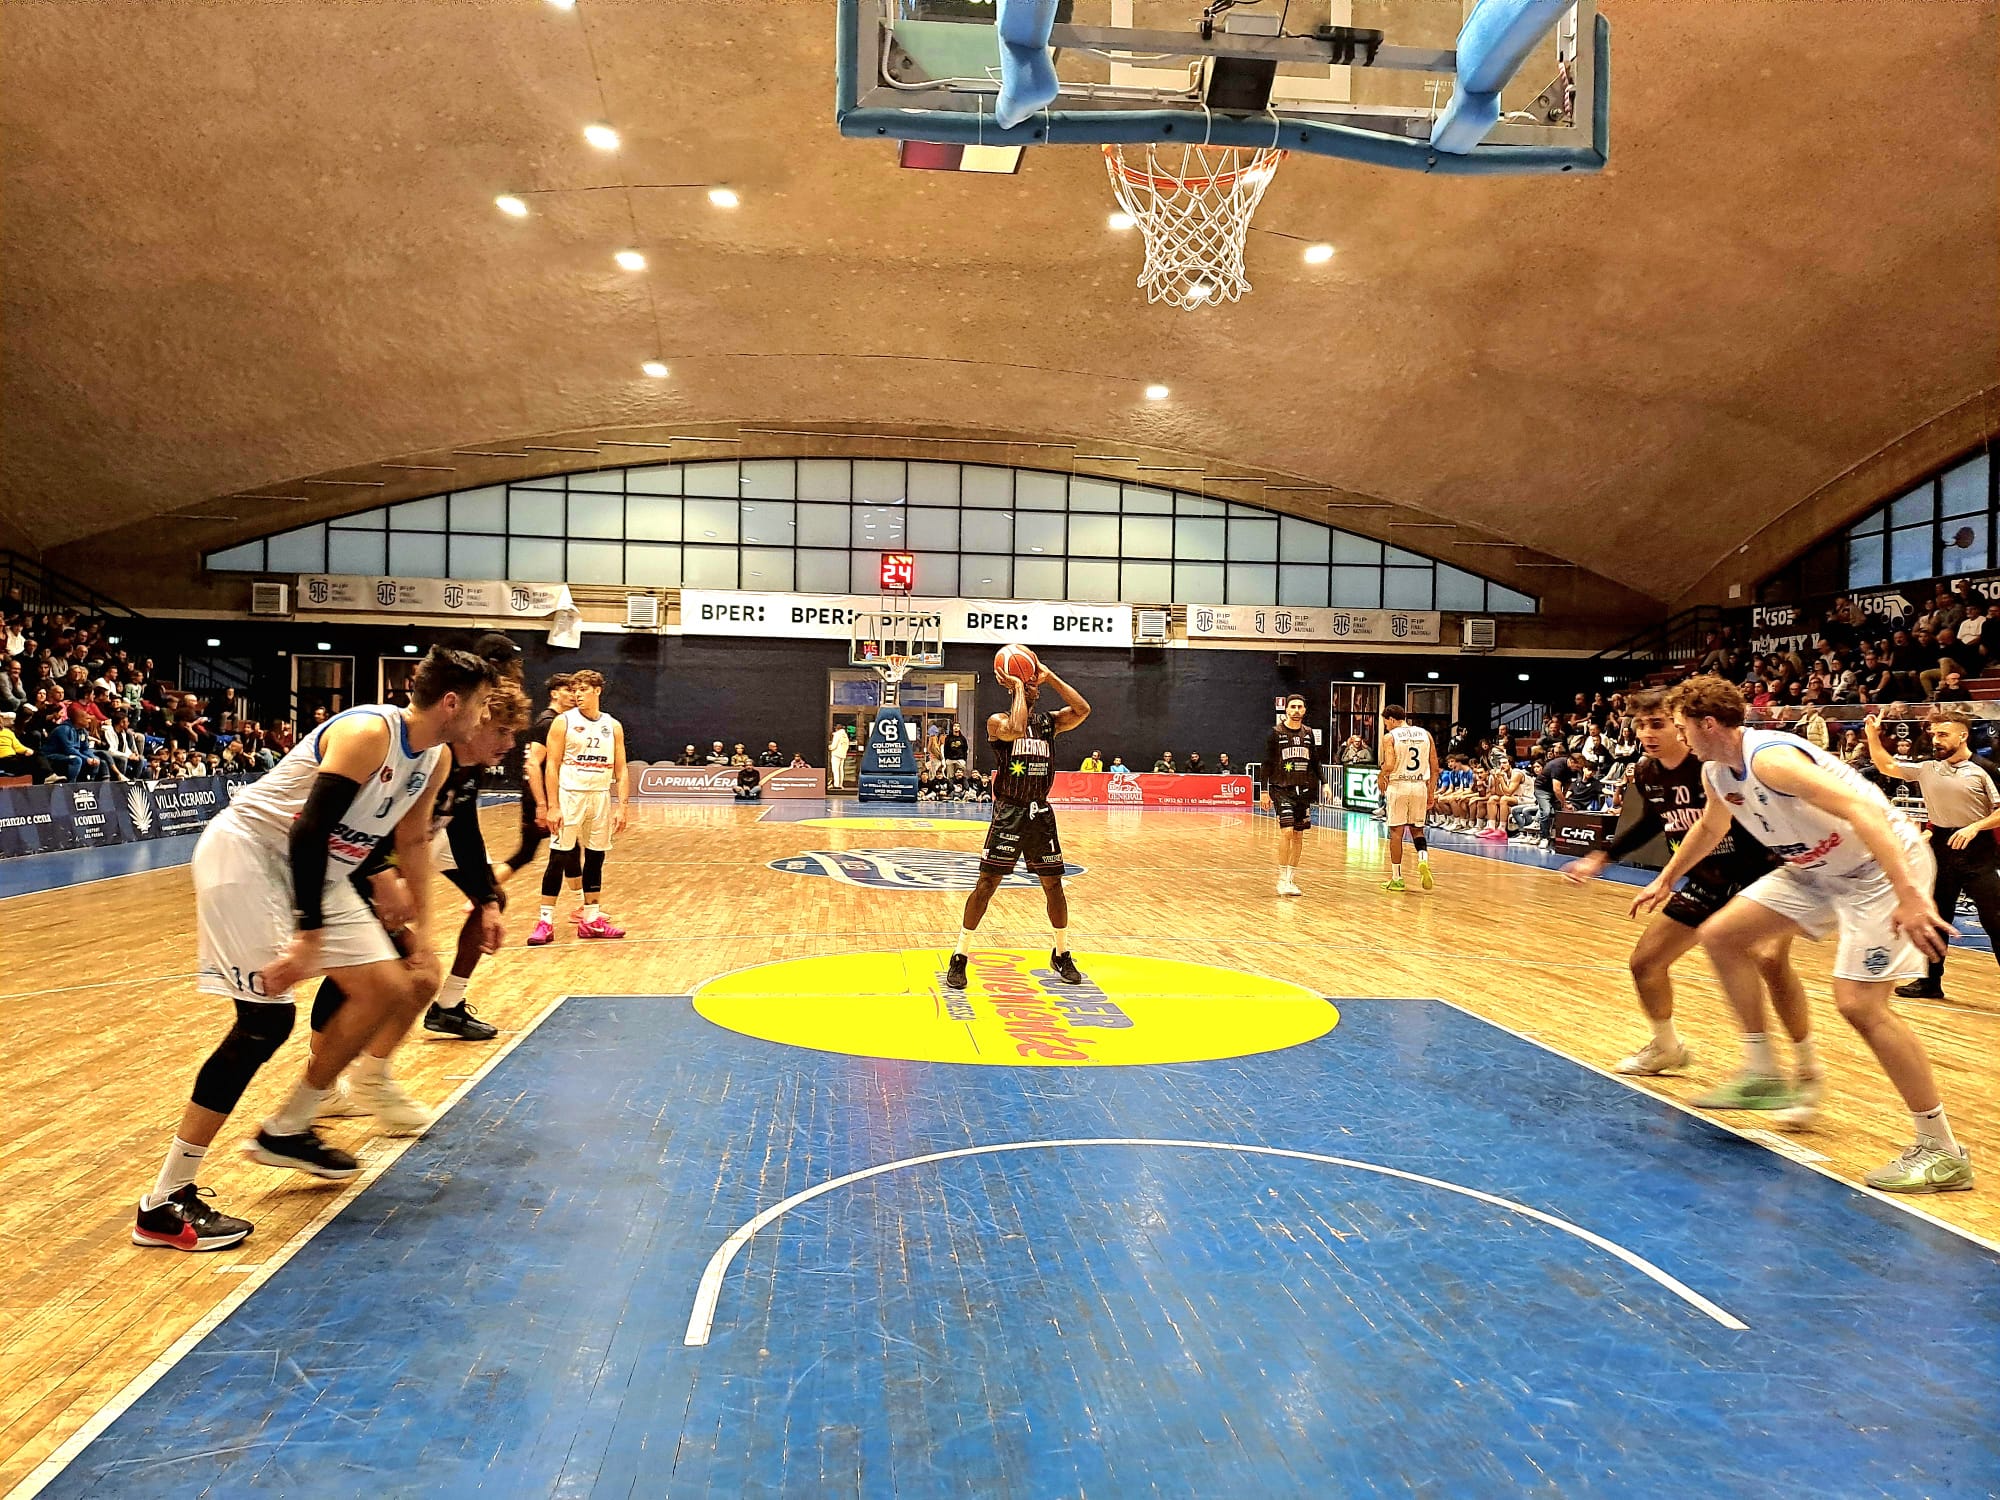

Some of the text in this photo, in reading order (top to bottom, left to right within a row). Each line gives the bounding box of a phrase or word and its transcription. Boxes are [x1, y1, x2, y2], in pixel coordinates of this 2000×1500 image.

[883, 565, 912, 583] 24
[701, 604, 765, 622] BPER:
[791, 607, 854, 625] BPER:
[967, 612, 1028, 631] BPER:
[1053, 615, 1113, 633] BPER:
[586, 737, 601, 749] 22
[576, 754, 608, 763] SUPER
[878, 756, 901, 764] MAXI
[1406, 746, 1420, 771] 3
[1221, 779, 1246, 794] Eligo
[155, 791, 216, 811] VILLA GERARDO
[1109, 792, 1143, 800] GENERALI
[1672, 786, 1691, 805] 20
[27, 816, 33, 824] e
[33, 813, 52, 824] cena
[77, 813, 106, 826] CORTILI
[1561, 826, 1595, 841] C-HR
[1048, 838, 1056, 852] 1
[968, 951, 1096, 1060] Conveniente
